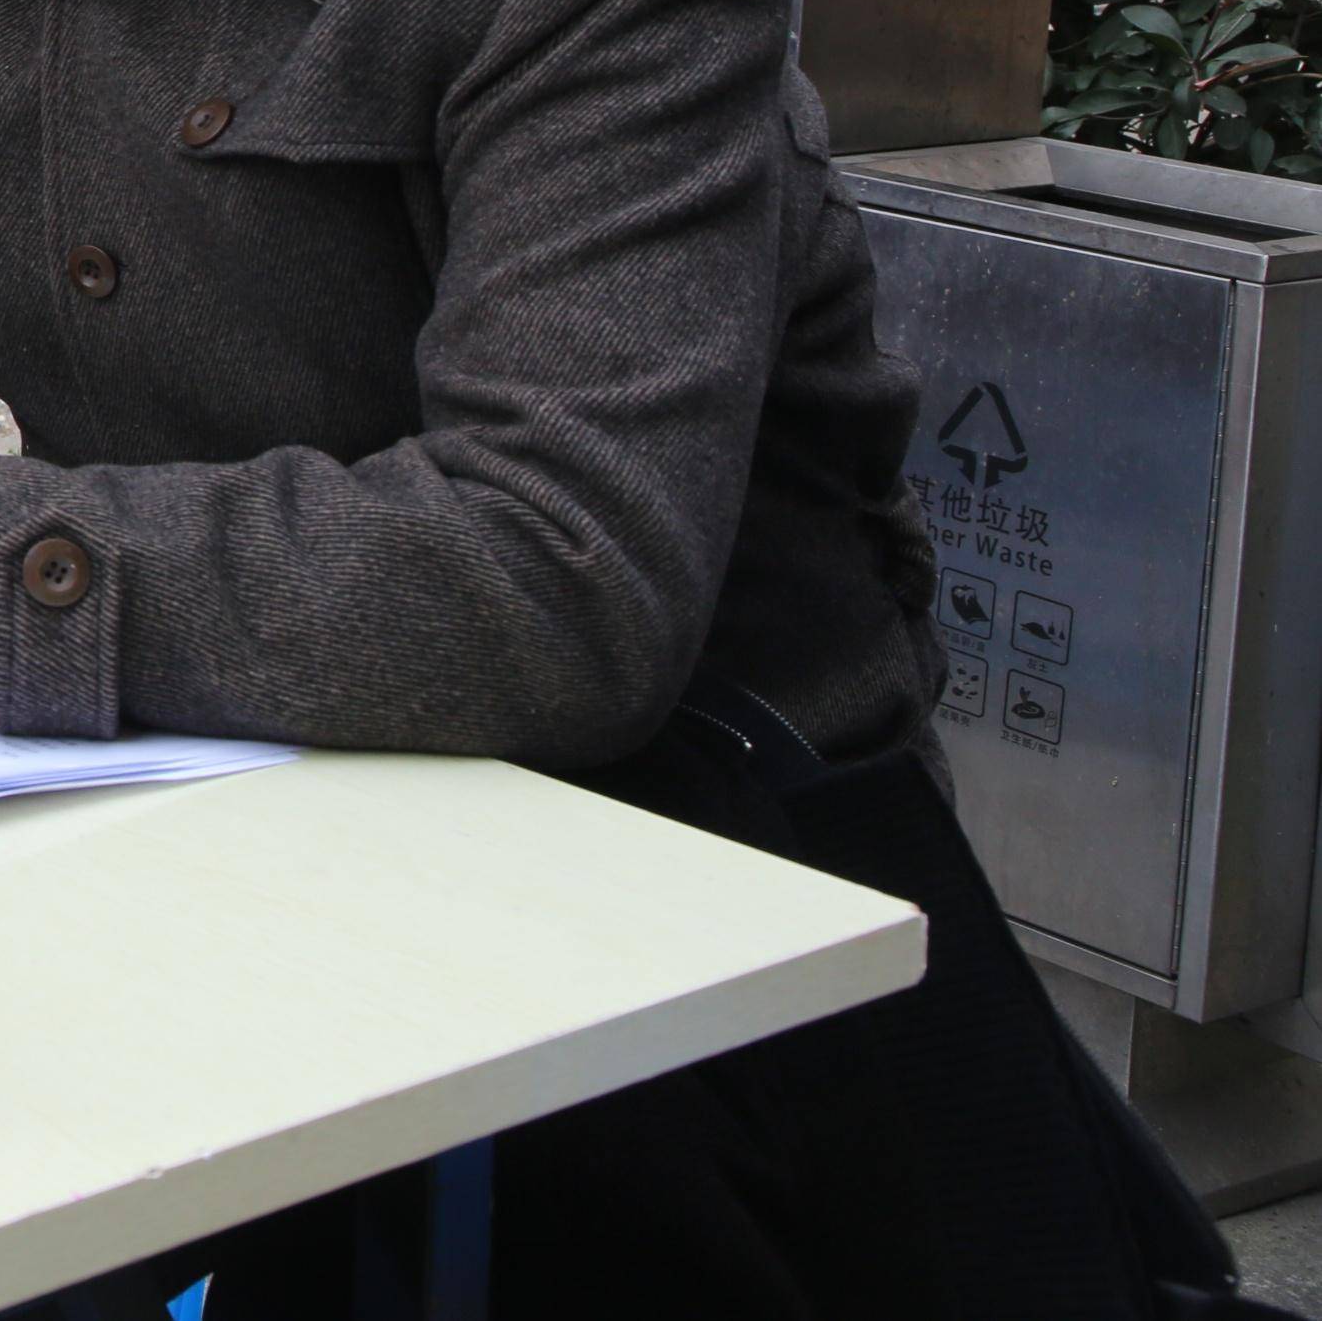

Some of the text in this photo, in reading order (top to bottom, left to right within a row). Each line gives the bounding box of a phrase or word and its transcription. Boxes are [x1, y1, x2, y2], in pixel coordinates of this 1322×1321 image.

[907, 474, 1049, 547] 其他垃圾
[975, 531, 1053, 577] Waste
